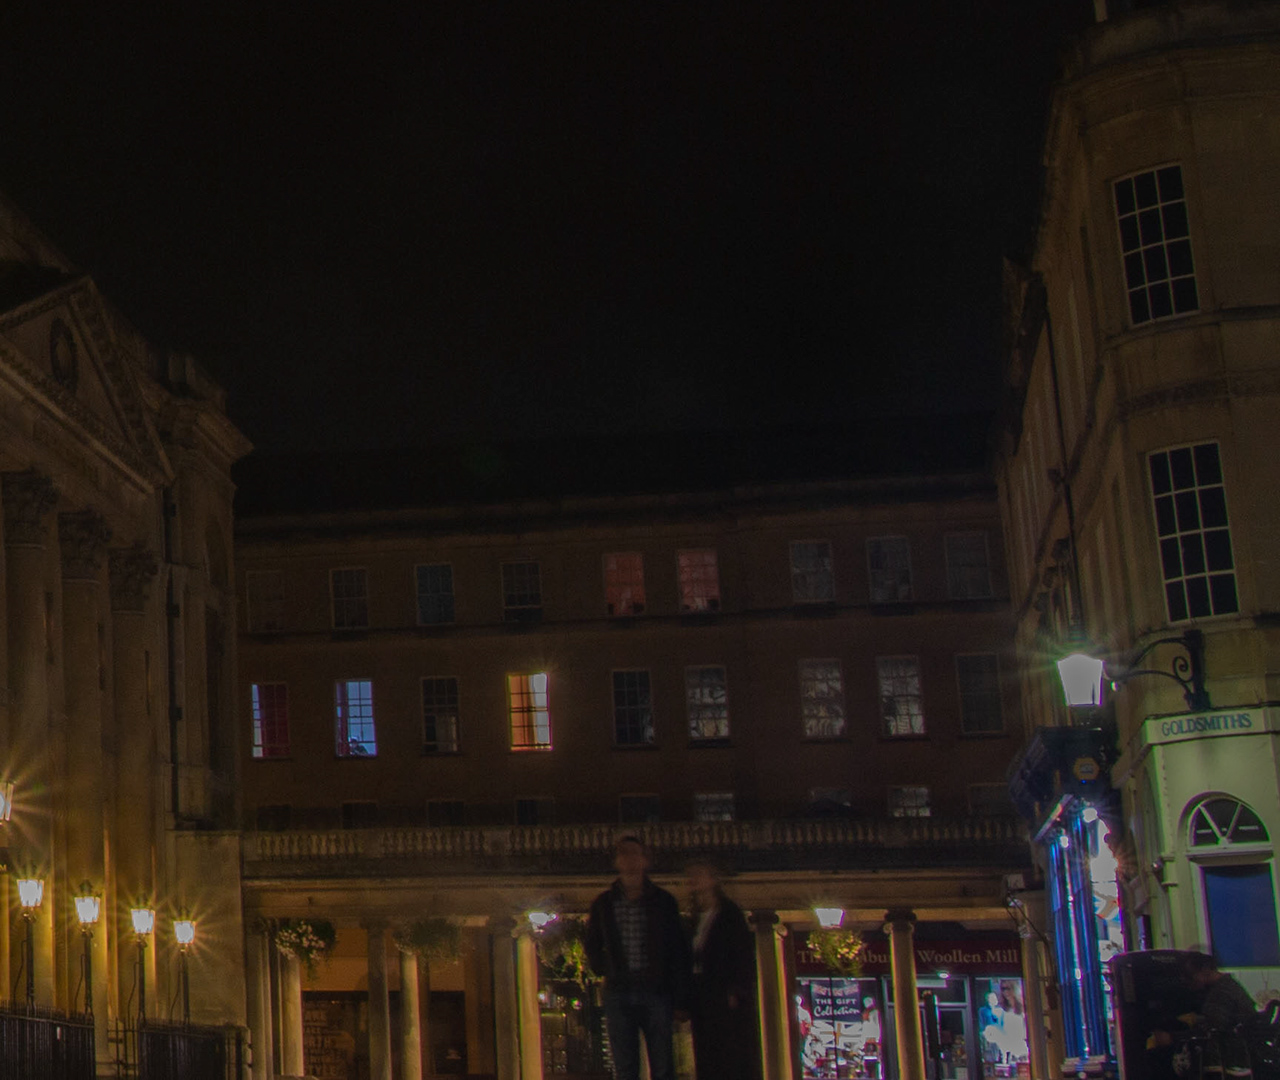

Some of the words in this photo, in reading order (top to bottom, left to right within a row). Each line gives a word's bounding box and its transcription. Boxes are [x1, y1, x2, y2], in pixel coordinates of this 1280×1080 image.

[1162, 713, 1252, 737] GOLDSMITHS
[917, 949, 981, 963] Woollen
[985, 949, 1019, 963] Mill
